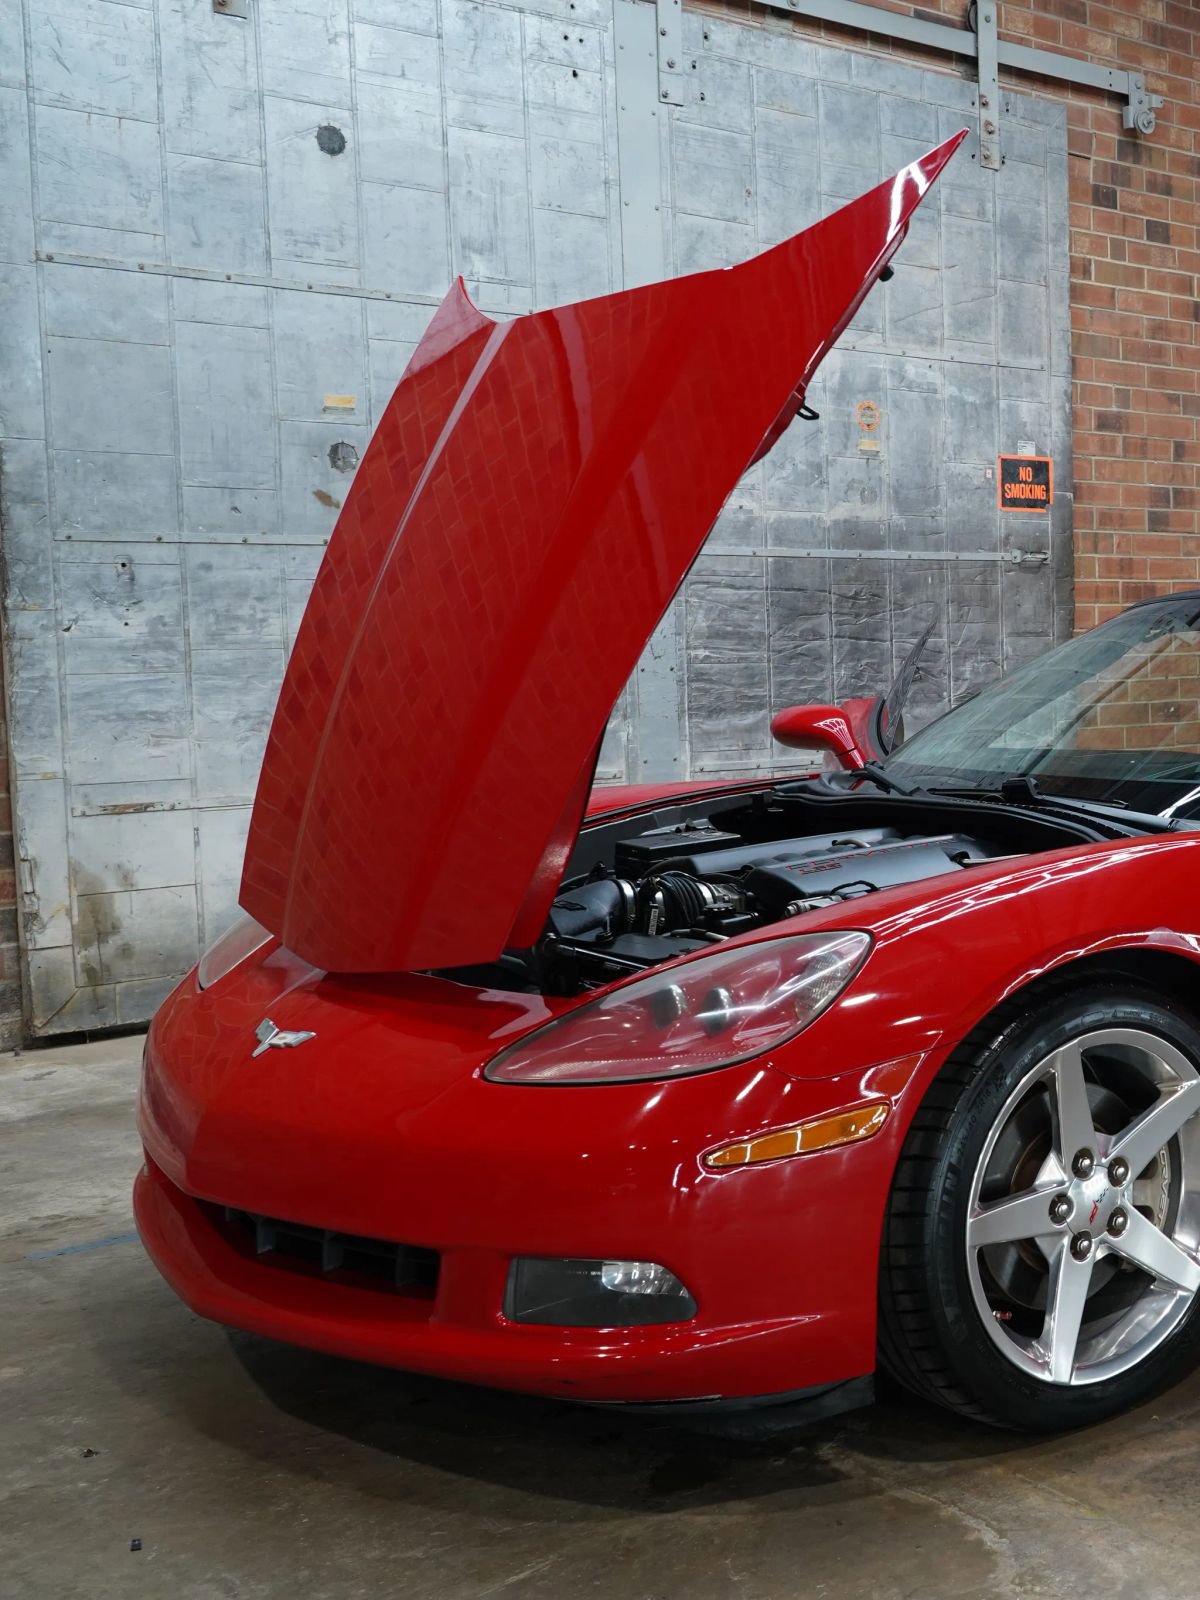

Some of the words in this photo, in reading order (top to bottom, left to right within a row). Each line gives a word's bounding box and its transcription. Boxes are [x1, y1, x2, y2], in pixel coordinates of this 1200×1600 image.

[1019, 466, 1033, 482] NO
[1004, 483, 1047, 500] SMOKING
[1158, 1146, 1169, 1228] ORVET
